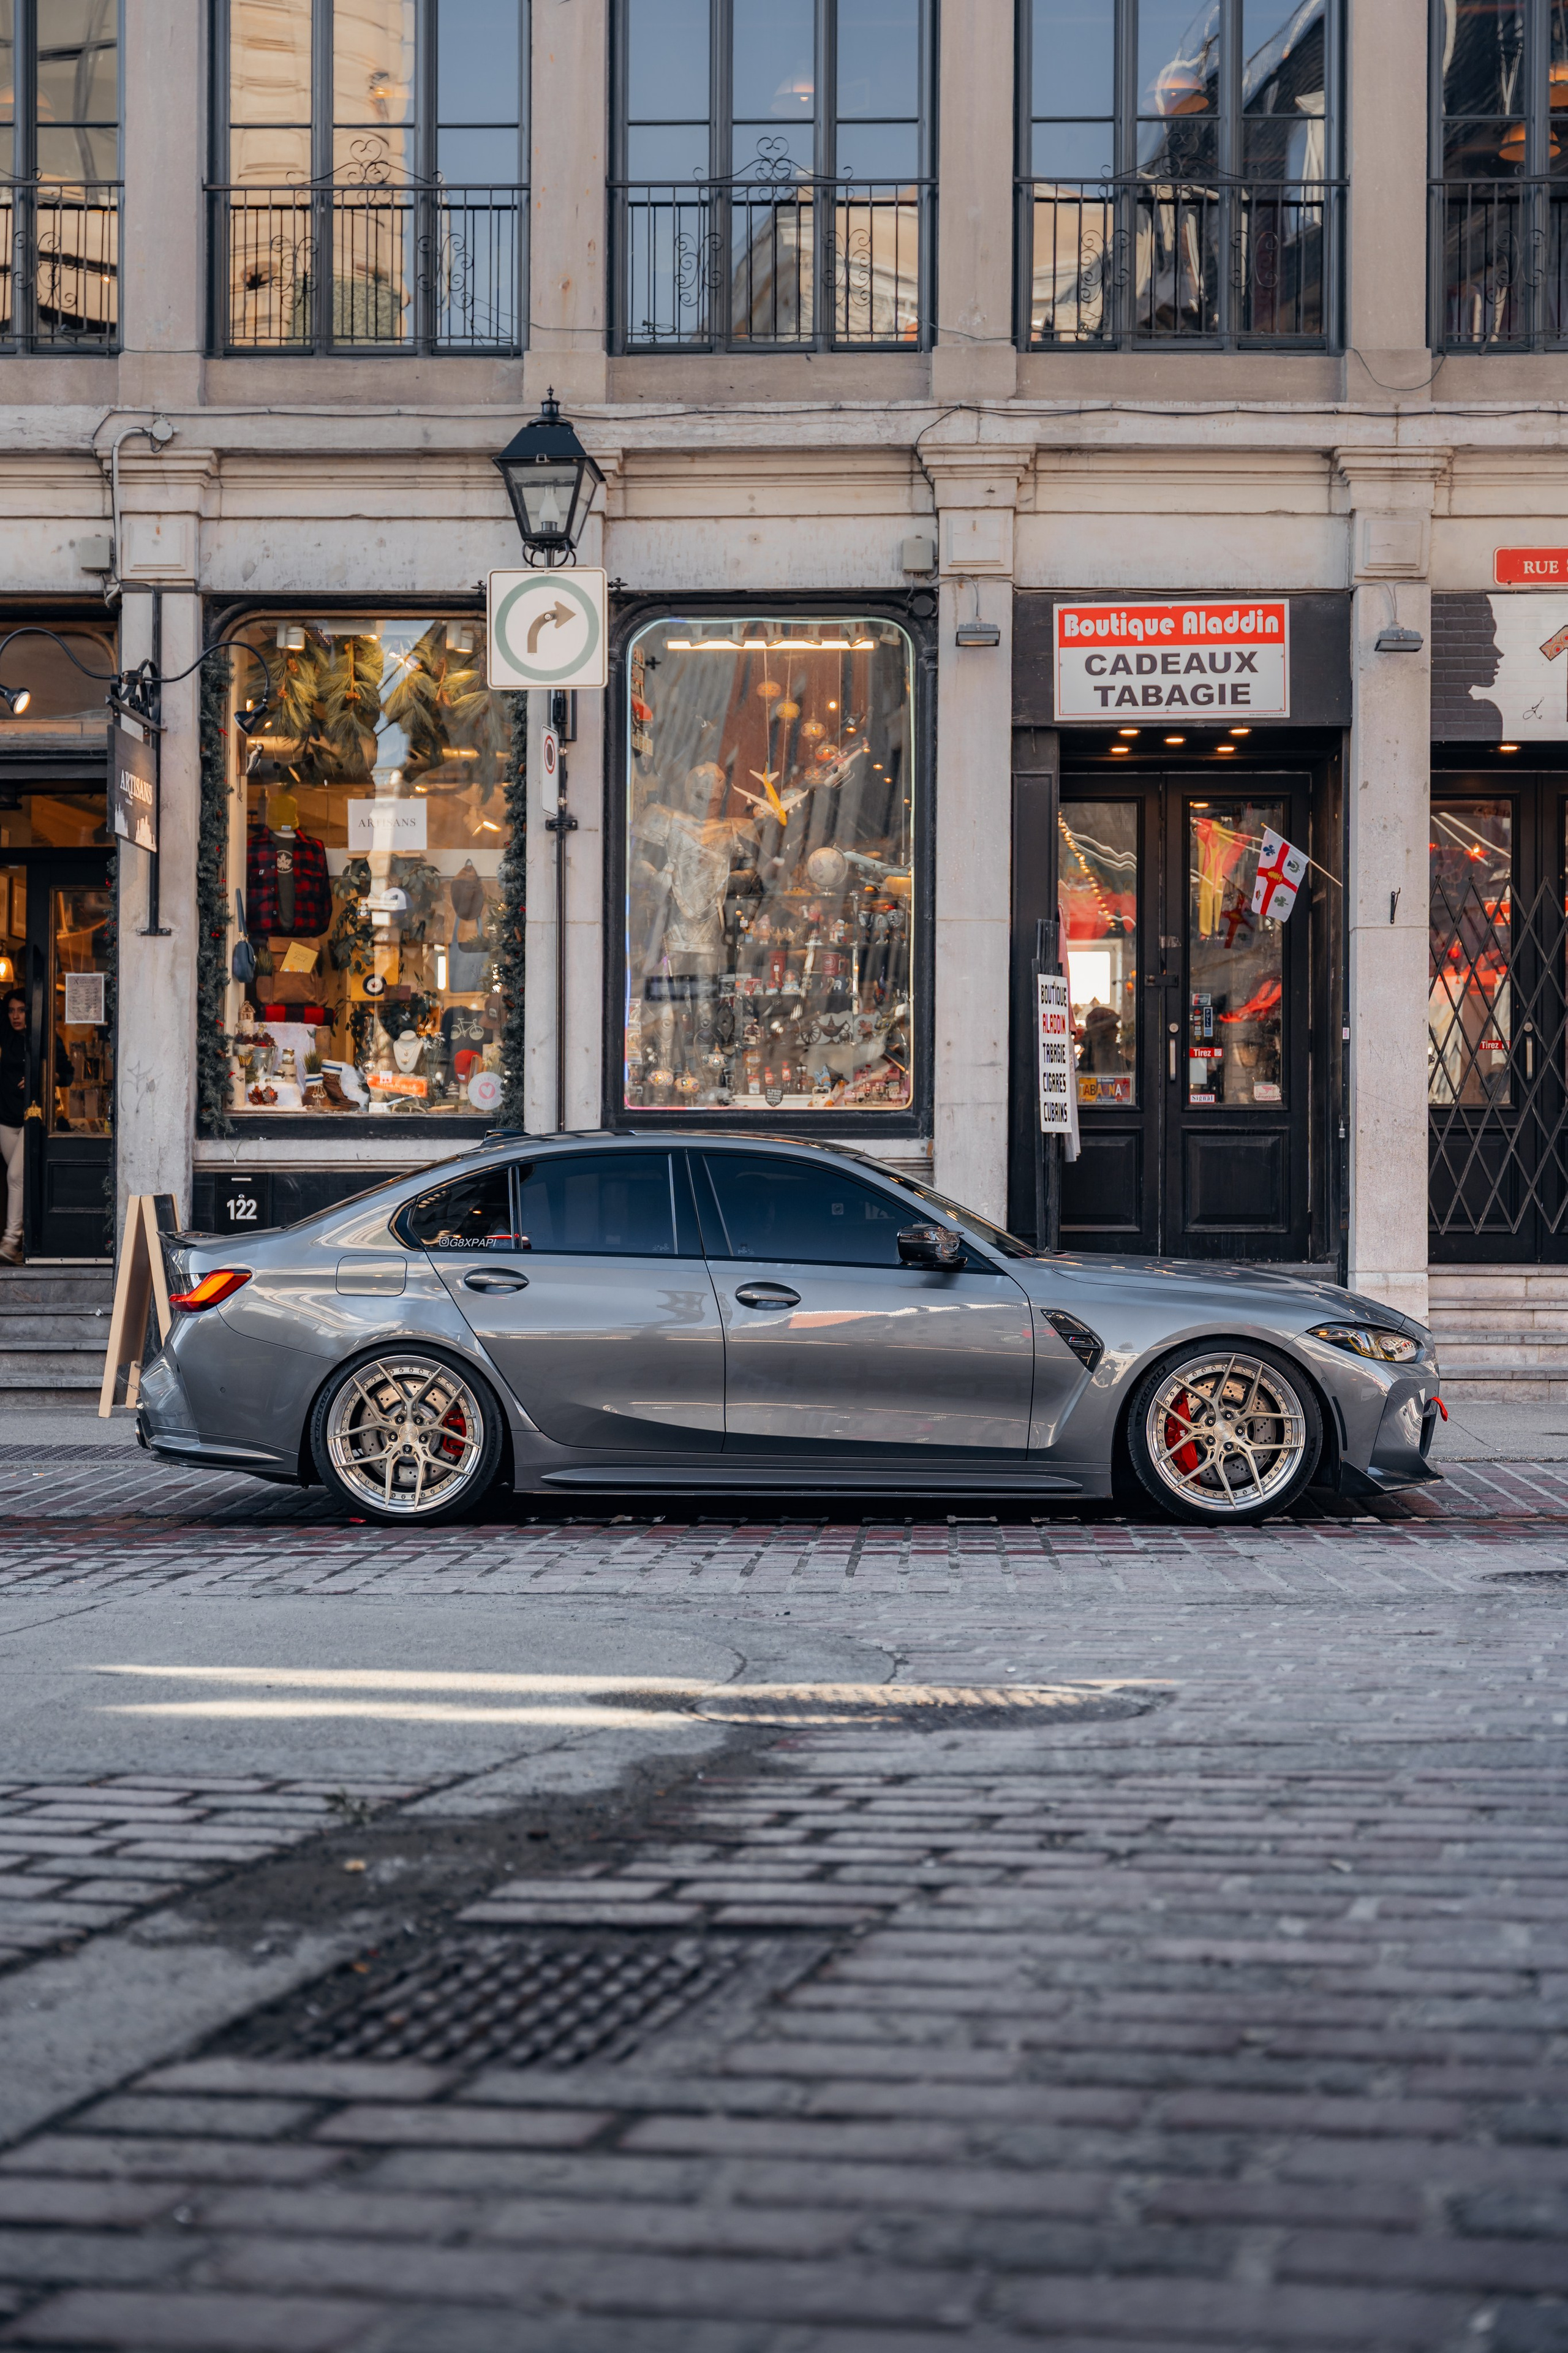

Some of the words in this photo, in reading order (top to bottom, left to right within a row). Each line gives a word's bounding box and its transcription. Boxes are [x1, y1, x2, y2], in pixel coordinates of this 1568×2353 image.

[1523, 561, 1559, 574] RUE
[1065, 611, 1175, 641] Boutique
[1183, 609, 1278, 635] Aladdin
[1085, 651, 1259, 676] CADEAUX
[1094, 683, 1251, 707] TABAGIE
[119, 769, 153, 806] ARTISANS
[358, 818, 416, 827] ARTISANS
[1041, 984, 1067, 1007] BOUTIQUE
[1042, 1013, 1066, 1035] ALADDIN
[1042, 1043, 1066, 1063] TABAGIE
[1043, 1072, 1066, 1093] CIGARES
[1044, 1101, 1068, 1122] CUBAINS
[227, 1199, 257, 1220] 122
[450, 1238, 497, 1247] G8XPAPI
[1138, 1367, 1165, 1414] MICHELIN
[314, 1389, 330, 1439] MICHELIN
